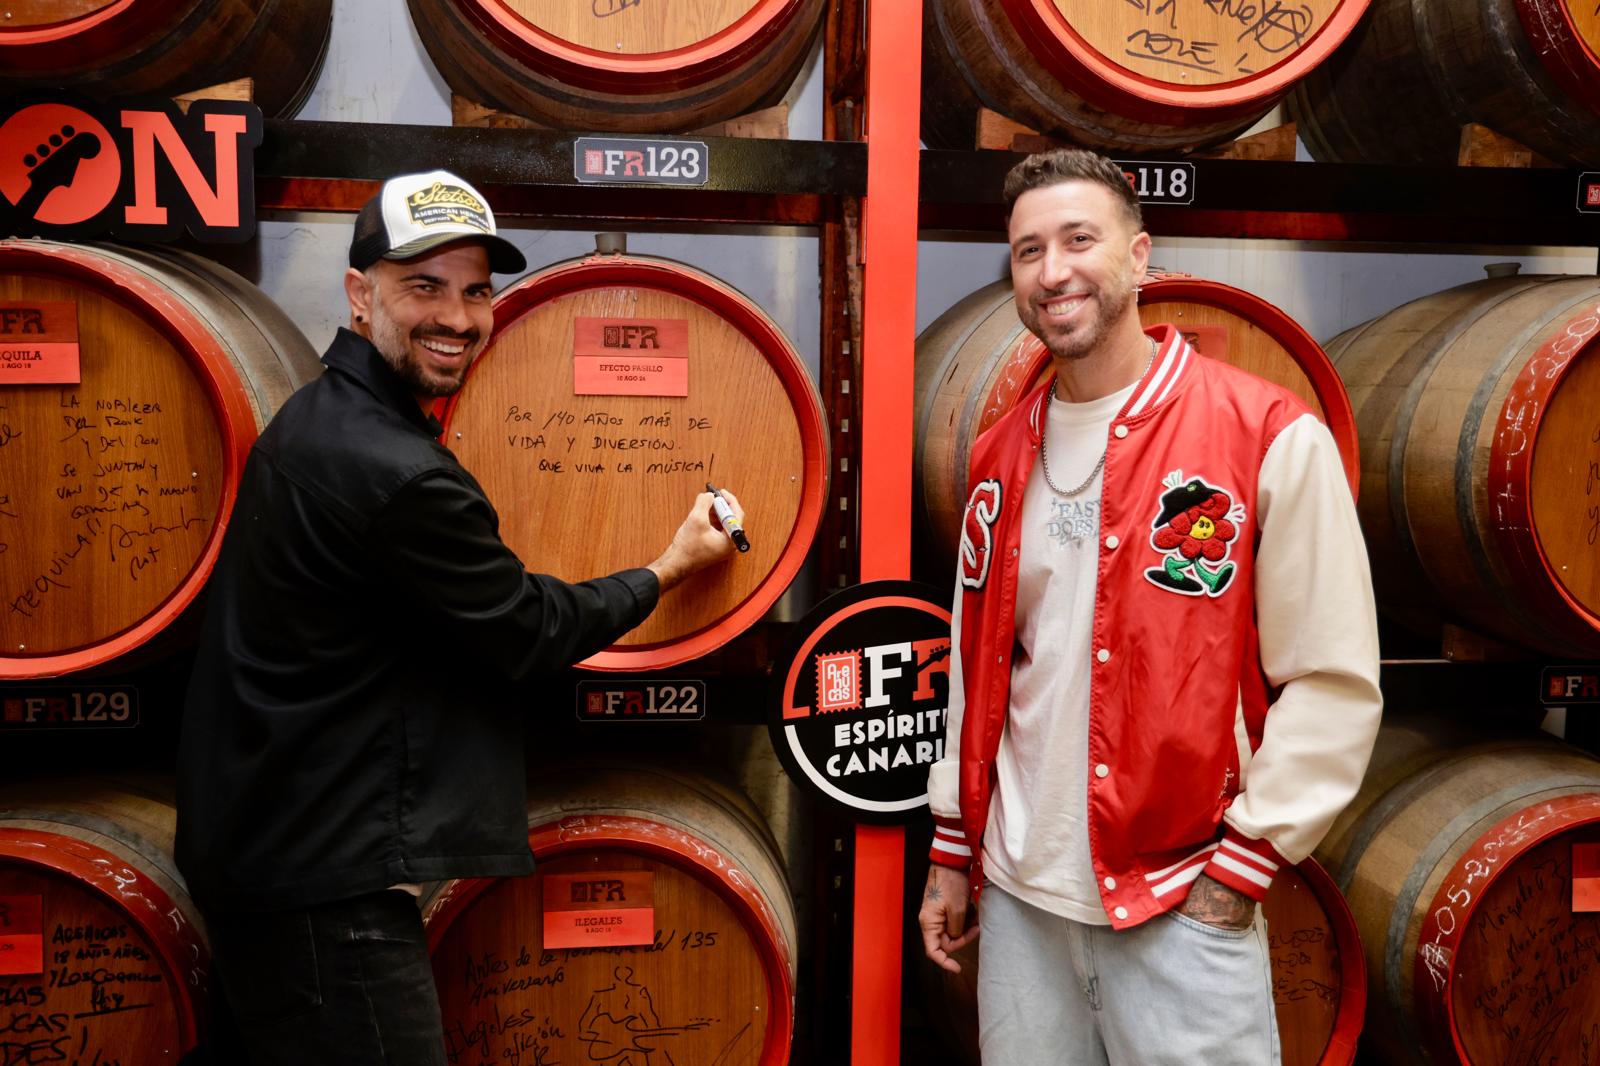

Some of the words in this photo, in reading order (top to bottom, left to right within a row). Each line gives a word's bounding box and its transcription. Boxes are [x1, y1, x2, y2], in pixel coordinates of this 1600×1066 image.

[605, 146, 700, 178] FR123
[410, 182, 485, 213] Stetson
[414, 208, 459, 219] AMERICAN
[621, 325, 660, 349] FR
[0, 350, 42, 361] QUILA
[599, 364, 631, 372] EFECTO
[632, 365, 663, 373] PASILLO
[583, 412, 624, 426] AÑOS
[687, 416, 713, 430] DE
[508, 434, 546, 449] VIDA
[566, 435, 576, 453] Y
[538, 458, 566, 474] QUE
[575, 462, 605, 474] VIVA
[617, 462, 633, 474] LA
[25, 692, 130, 722] FR129
[605, 686, 698, 714] FR122
[575, 917, 623, 927] ILEGALES
[681, 930, 718, 951] 135
